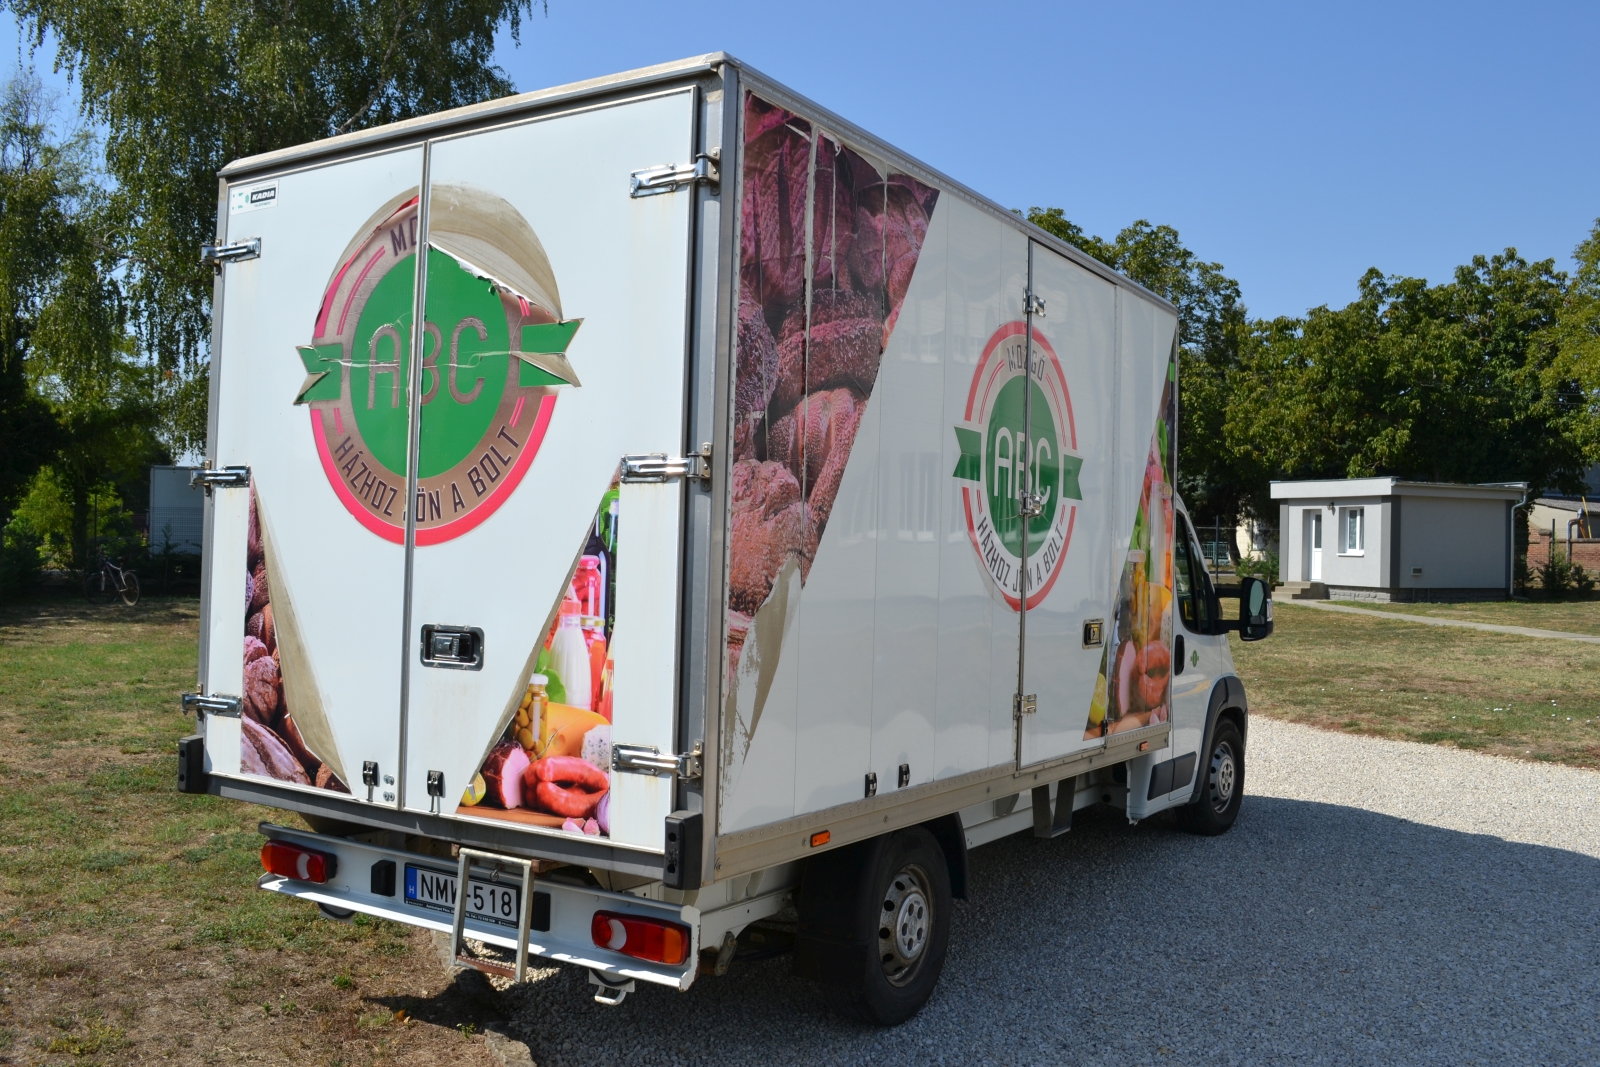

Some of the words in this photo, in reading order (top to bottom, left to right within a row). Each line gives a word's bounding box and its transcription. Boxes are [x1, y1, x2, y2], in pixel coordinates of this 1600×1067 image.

[252, 190, 275, 201] KADIA
[367, 316, 487, 409] ABC
[1007, 344, 1046, 382] MOGÓ
[334, 435, 399, 517] HÁZHOZ
[403, 486, 442, 523] ÖN
[451, 481, 465, 513] A
[466, 425, 519, 498] BOLT
[994, 426, 1052, 505] ABC
[977, 516, 1011, 588] HÁZHOZ
[1036, 562, 1043, 586] A
[1042, 523, 1064, 575] BOLT
[408, 885, 415, 895] H
